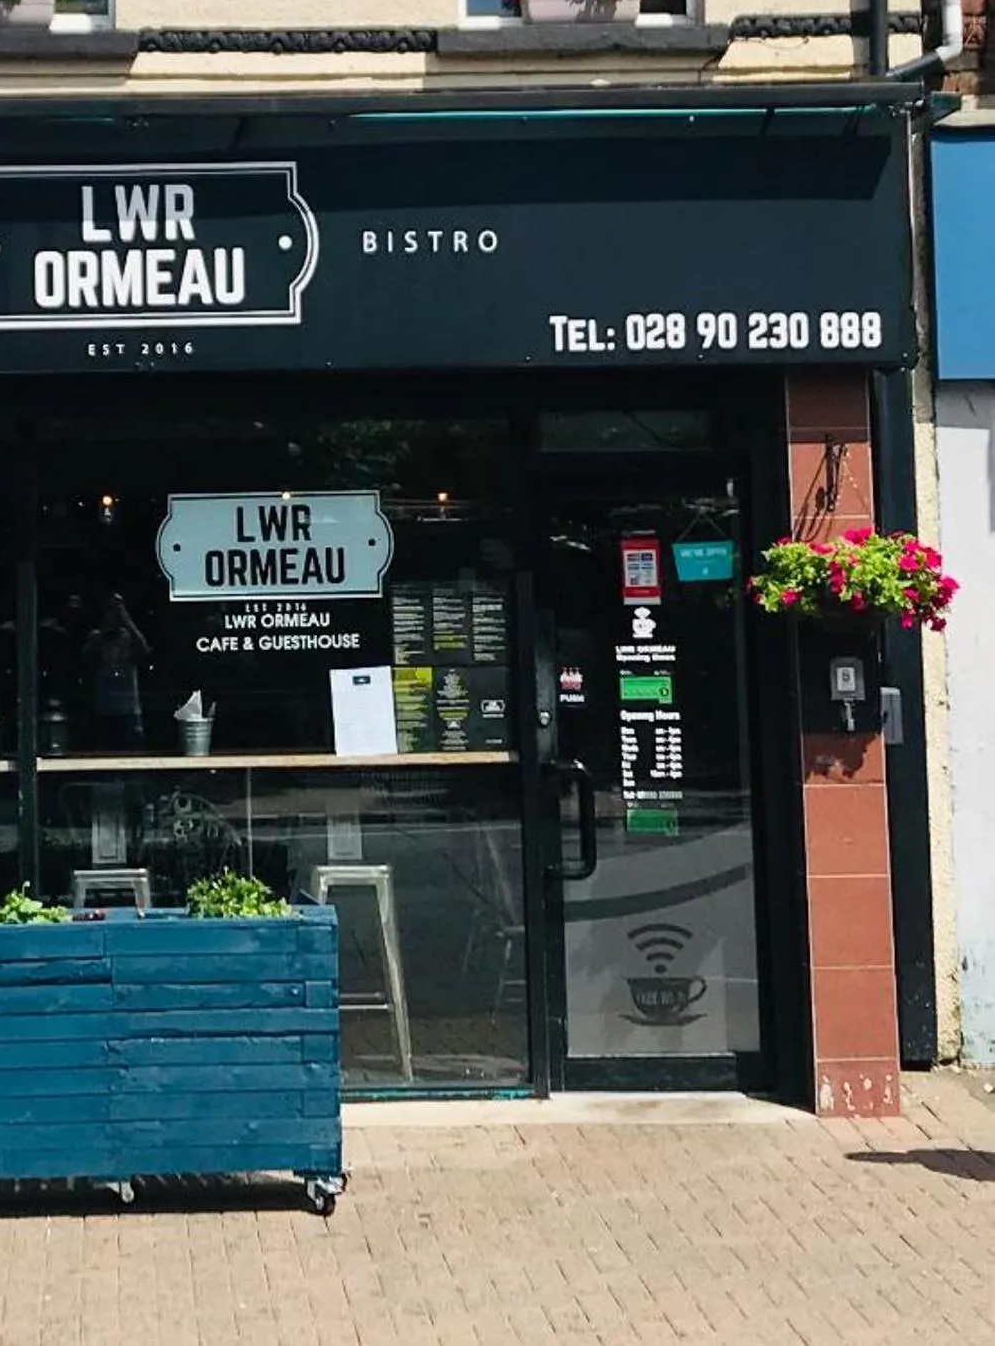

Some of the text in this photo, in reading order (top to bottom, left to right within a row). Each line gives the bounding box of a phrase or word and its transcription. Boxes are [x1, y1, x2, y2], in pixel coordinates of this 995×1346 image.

[81, 184, 196, 242] LWR
[362, 230, 499, 253] BISTRO
[34, 247, 246, 308] ORMEAU
[88, 341, 194, 356] EST 2016
[626, 313, 687, 351] 028
[696, 313, 738, 349] 90
[748, 312, 809, 348] 230
[819, 311, 883, 348] 888
[236, 504, 311, 543] LWR
[205, 547, 346, 587] ORMEAU
[224, 612, 331, 630] LWR ORMEAU
[195, 633, 361, 652] CAFE & GUESTHOUSE
